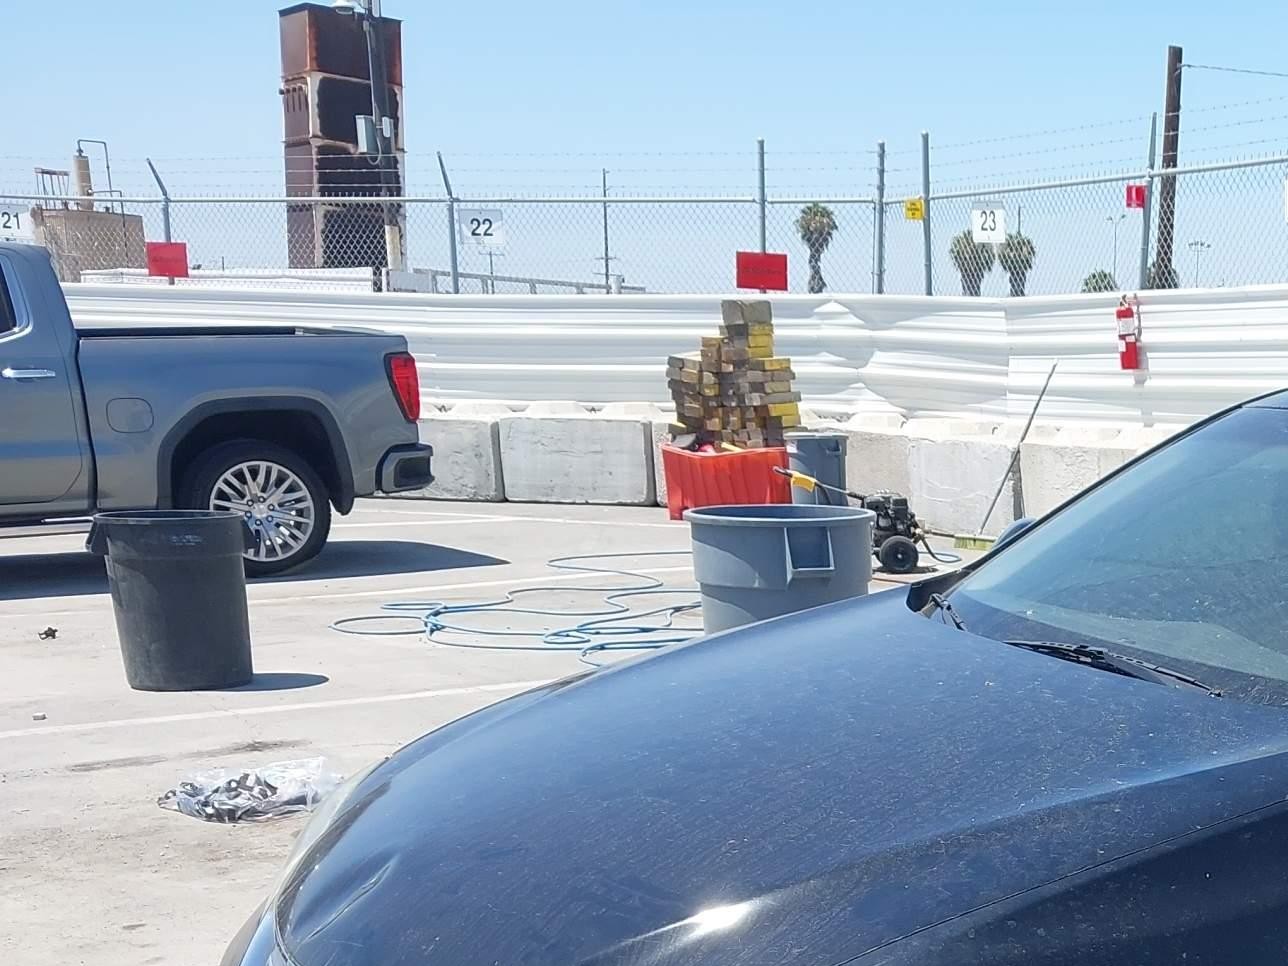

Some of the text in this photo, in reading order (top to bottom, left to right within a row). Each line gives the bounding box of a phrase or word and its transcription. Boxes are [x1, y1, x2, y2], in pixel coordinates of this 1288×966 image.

[1, 211, 21, 230] 21
[470, 217, 494, 237] 22
[980, 209, 997, 232] 23
